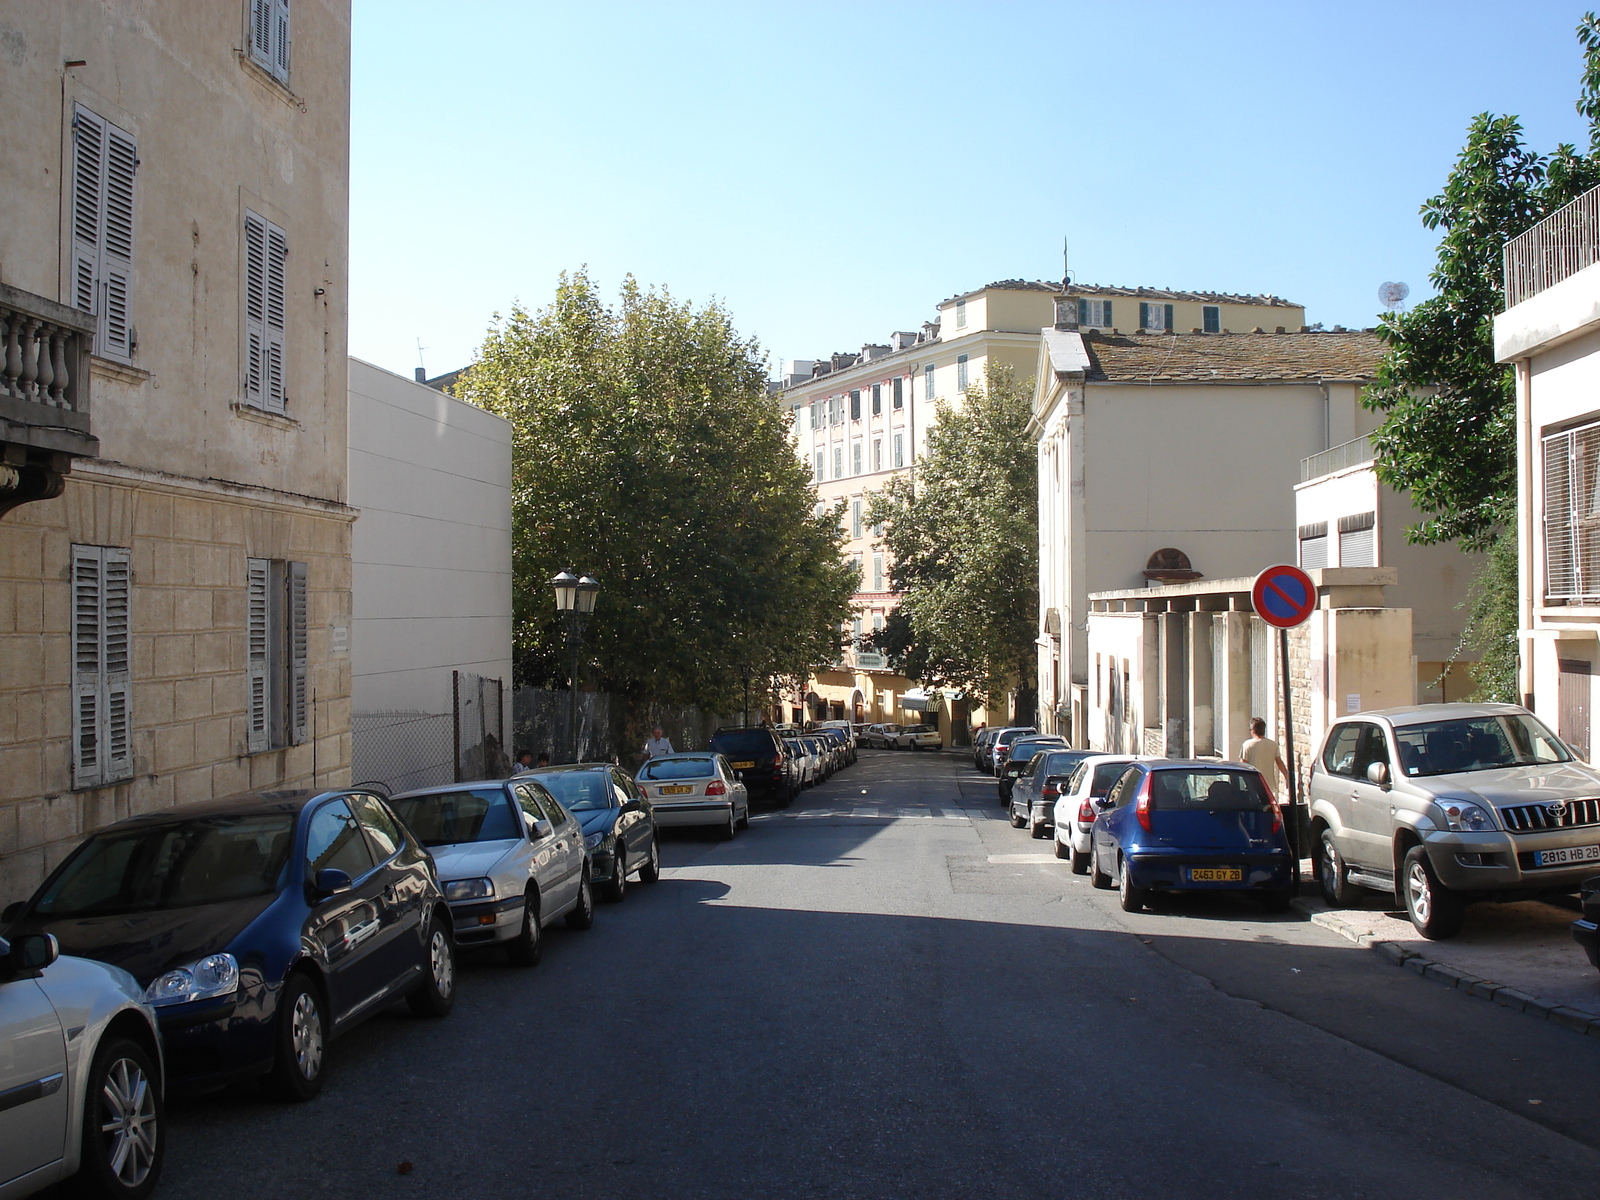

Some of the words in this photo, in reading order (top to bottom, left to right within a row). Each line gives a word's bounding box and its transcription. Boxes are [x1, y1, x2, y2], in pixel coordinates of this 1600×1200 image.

[1541, 850, 1567, 863] 2813
[1570, 849, 1583, 860] HB
[1585, 847, 1599, 858] 2B
[1193, 870, 1213, 880] 2463
[1216, 870, 1227, 880] GY
[1230, 870, 1240, 880] 2B
